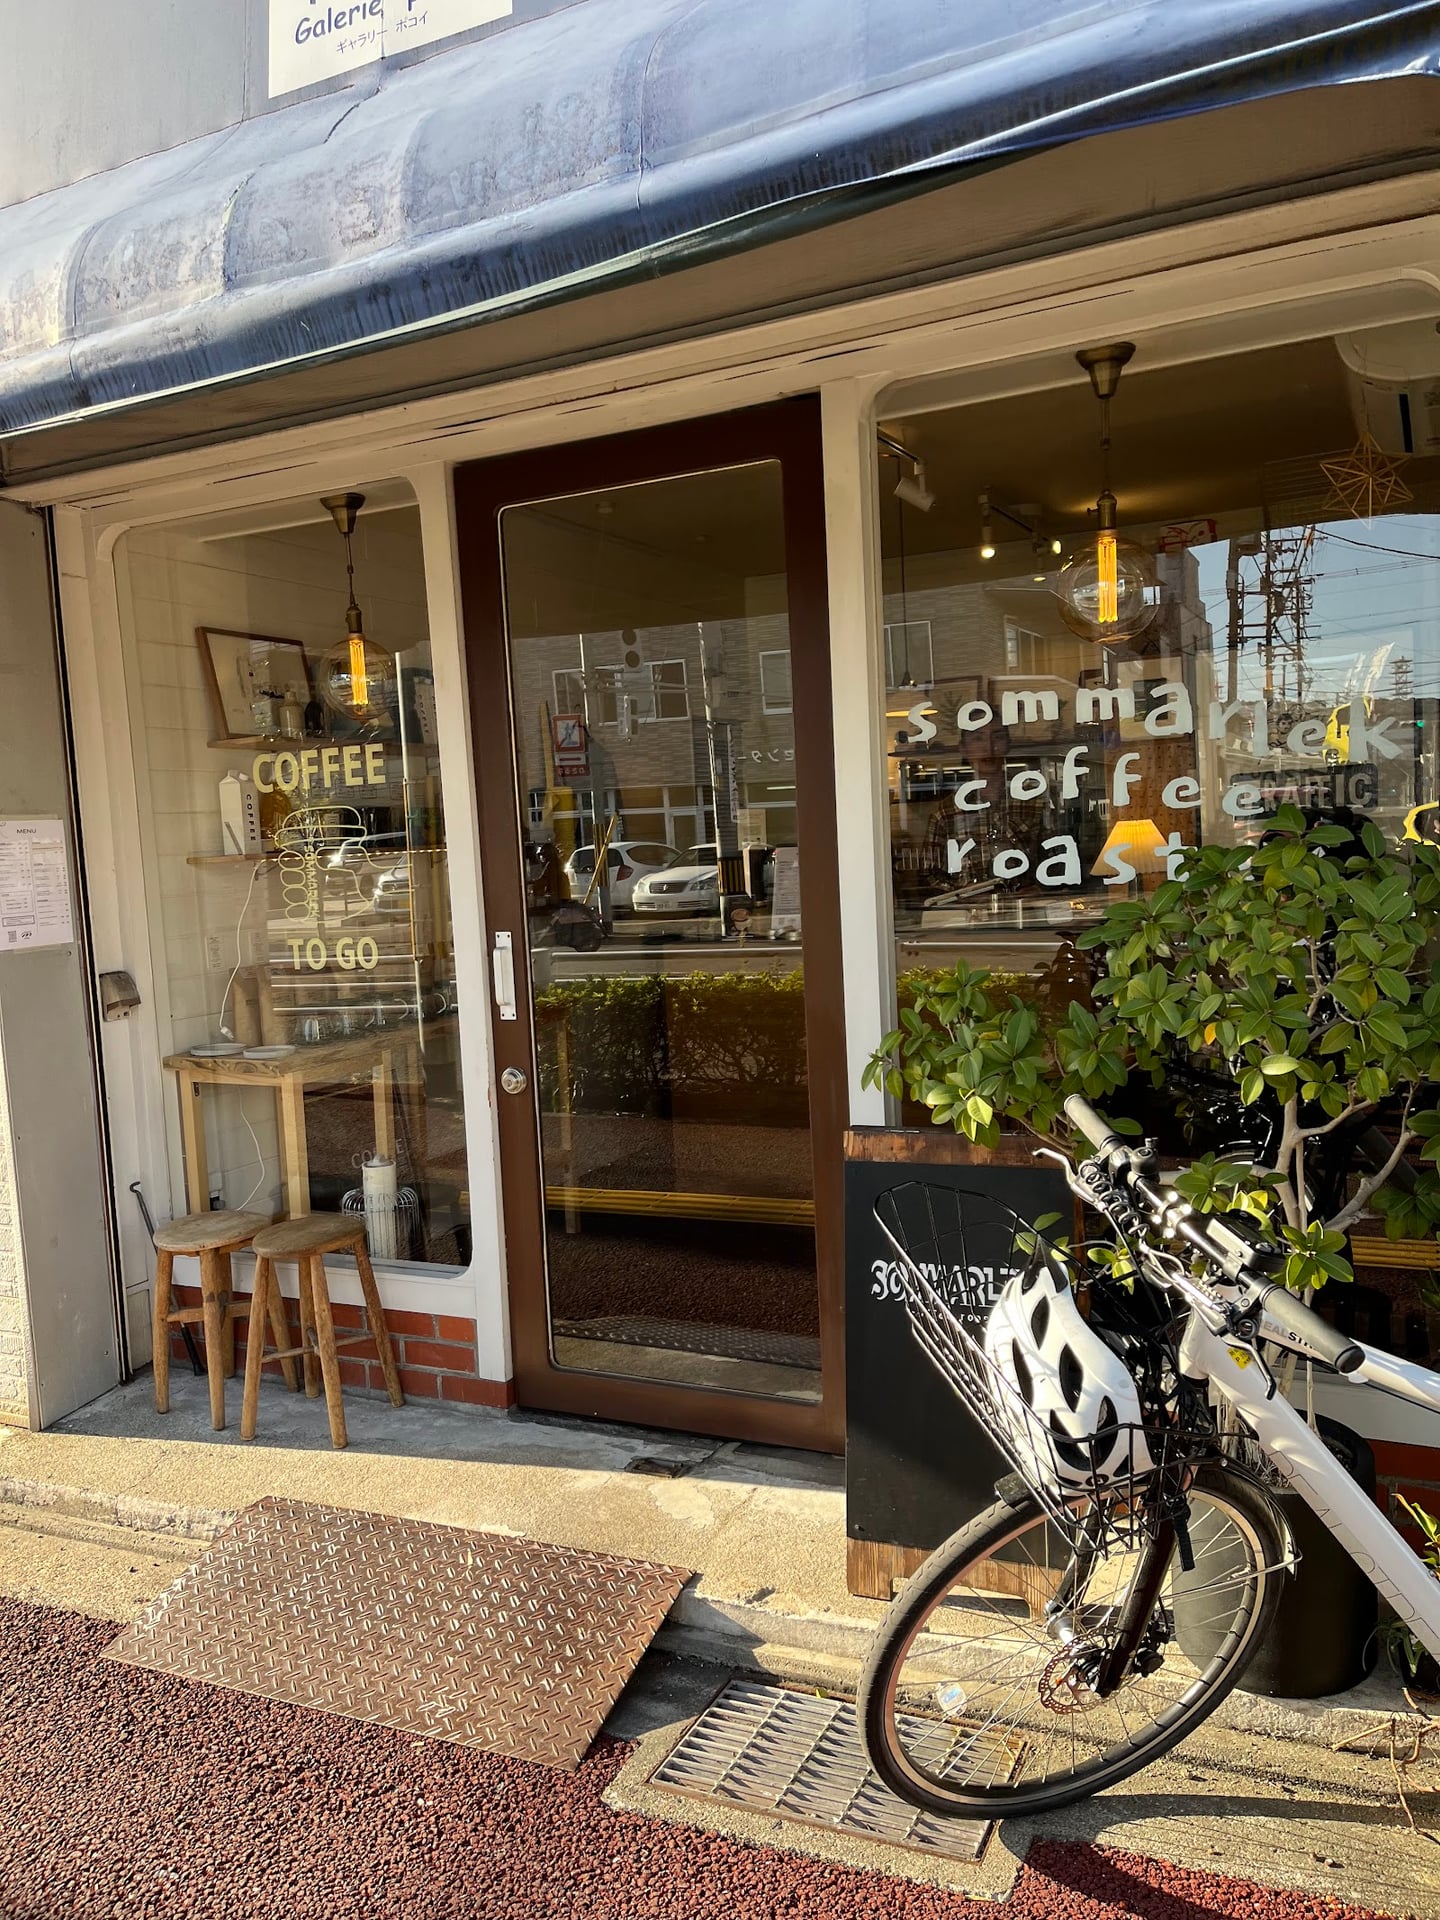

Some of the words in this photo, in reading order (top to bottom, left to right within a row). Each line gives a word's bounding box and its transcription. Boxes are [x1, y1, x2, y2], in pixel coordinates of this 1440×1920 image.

[295, 0, 383, 44] Galerie
[336, 30, 388, 53] ギャラリー
[252, 743, 386, 793] COFFEE
[954, 745, 1265, 817] coffee
[246, 793, 257, 841] COFFEE
[287, 937, 328, 971] TO
[335, 936, 379, 970] GO
